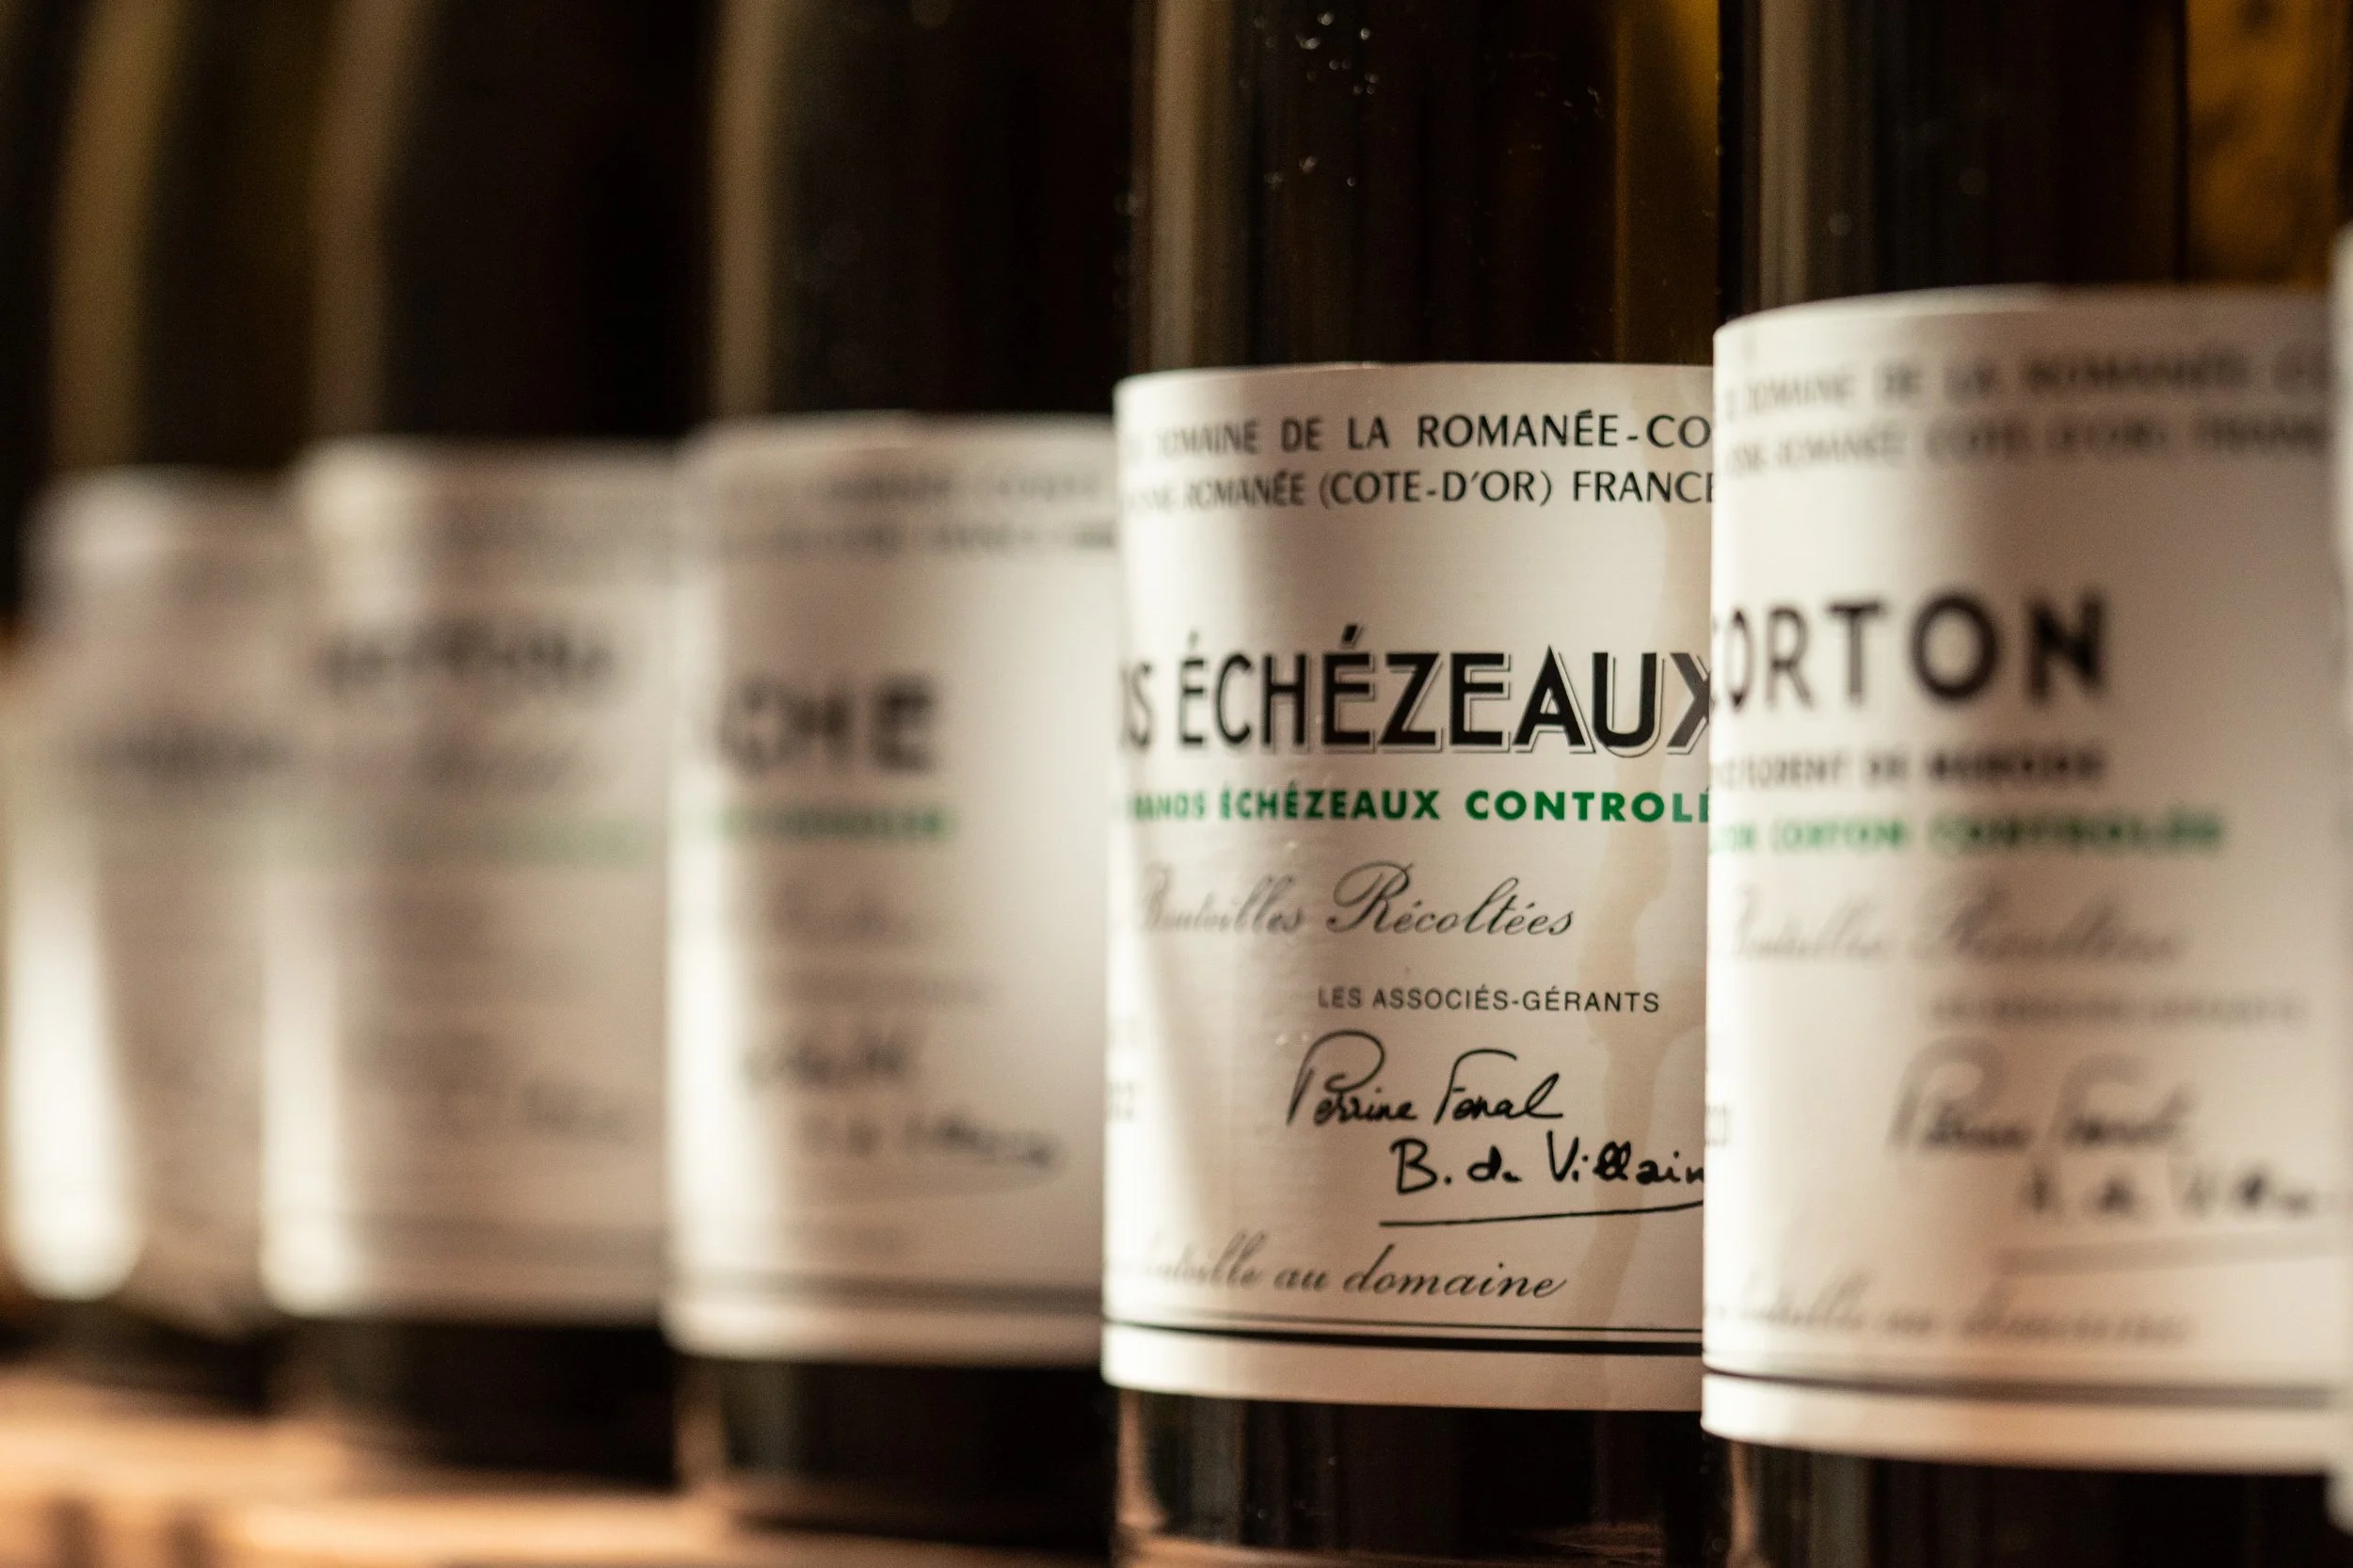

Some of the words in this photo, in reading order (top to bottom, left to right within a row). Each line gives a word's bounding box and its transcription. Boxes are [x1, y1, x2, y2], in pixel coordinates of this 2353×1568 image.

[1280, 414, 1324, 454] DE
[1348, 415, 1390, 450] LA
[1712, 584, 2112, 715] ORTON
[1178, 624, 1712, 759] ÉCHÉZEAUX
[1220, 779, 1441, 822] ÉCHÉZEAUX
[1325, 860, 1576, 936] Récoltées
[1318, 984, 1363, 1011] LES
[1371, 982, 1661, 1015] ASSOCIÉS-GÉRANTS
[1389, 1137, 1452, 1196] B.
[1273, 1268, 1330, 1293] au
[1342, 1243, 1568, 1299] domaine
